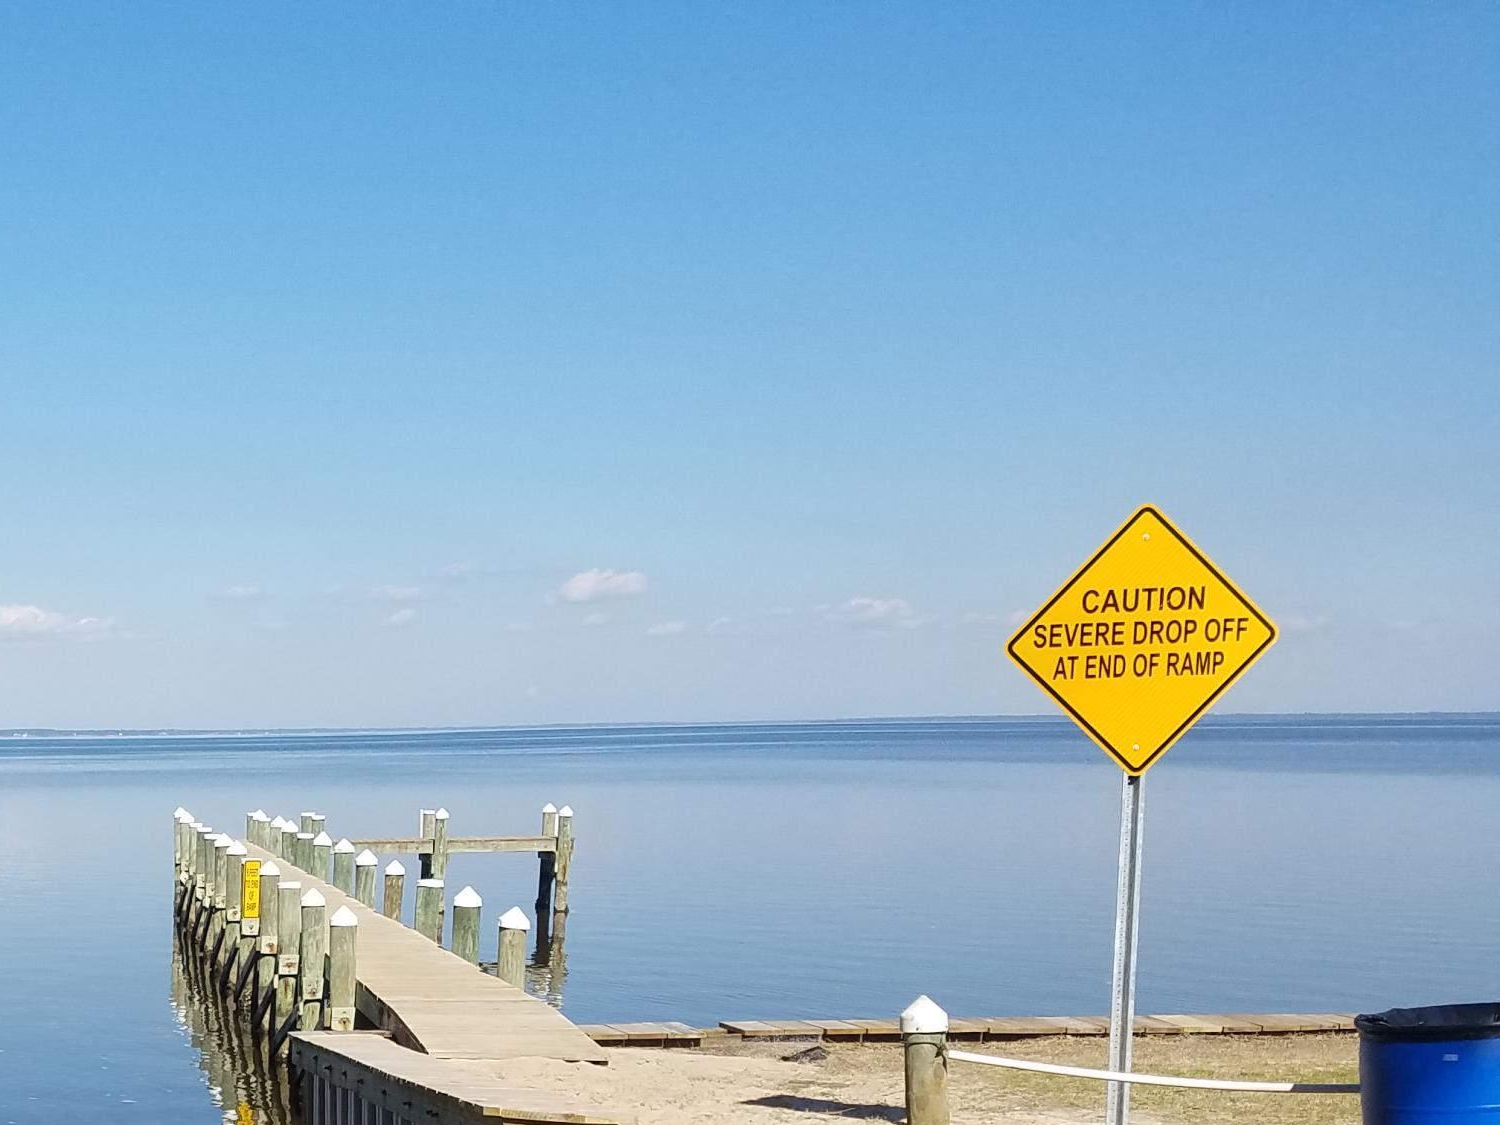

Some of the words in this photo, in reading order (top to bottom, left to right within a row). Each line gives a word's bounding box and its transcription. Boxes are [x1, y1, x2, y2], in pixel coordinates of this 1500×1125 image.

[1082, 585, 1206, 615] CAUTION
[1032, 621, 1126, 649] SEVERE
[1132, 619, 1198, 646] DROP
[1204, 617, 1250, 643] OFF
[1052, 655, 1080, 681] AT
[1084, 653, 1127, 680] END
[1132, 652, 1161, 678] OF
[1166, 650, 1225, 677] RAMP
